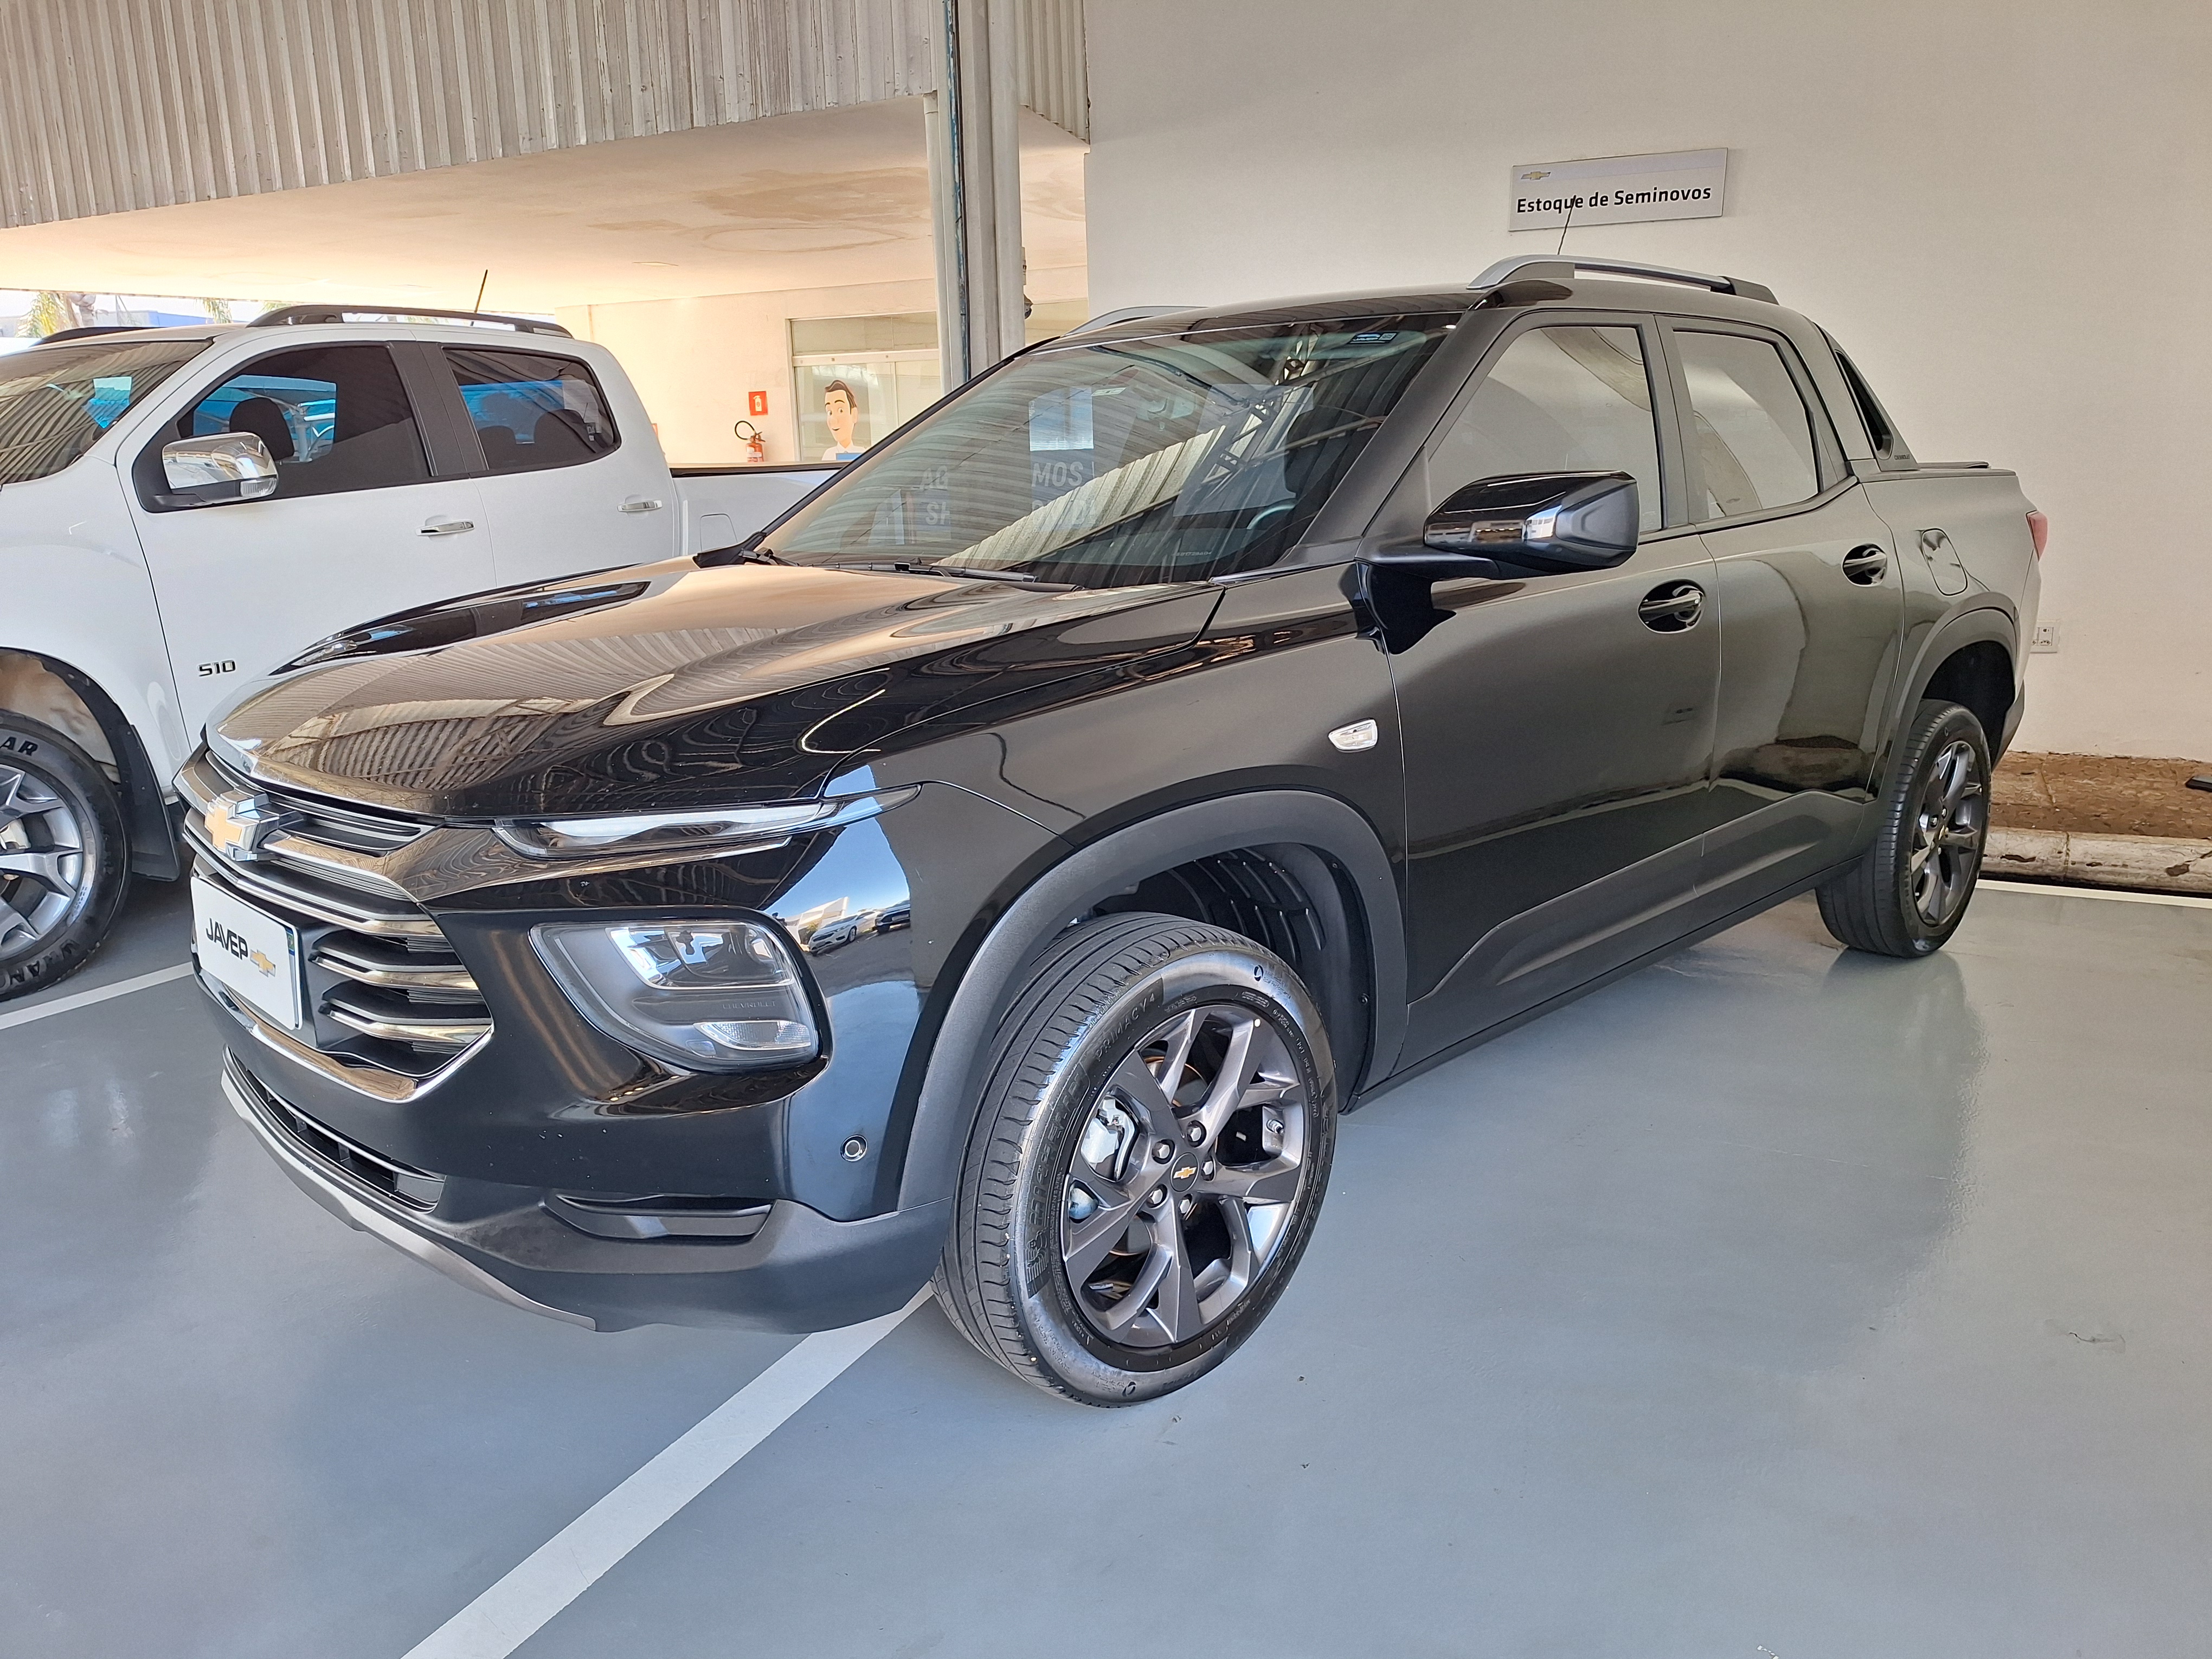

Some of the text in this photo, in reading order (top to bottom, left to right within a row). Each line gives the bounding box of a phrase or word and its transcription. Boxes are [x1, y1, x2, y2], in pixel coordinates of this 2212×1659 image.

[1517, 187, 1711, 214] Estoque de Seminovos
[198, 659, 236, 677] S10
[205, 917, 248, 961] JAVEP
